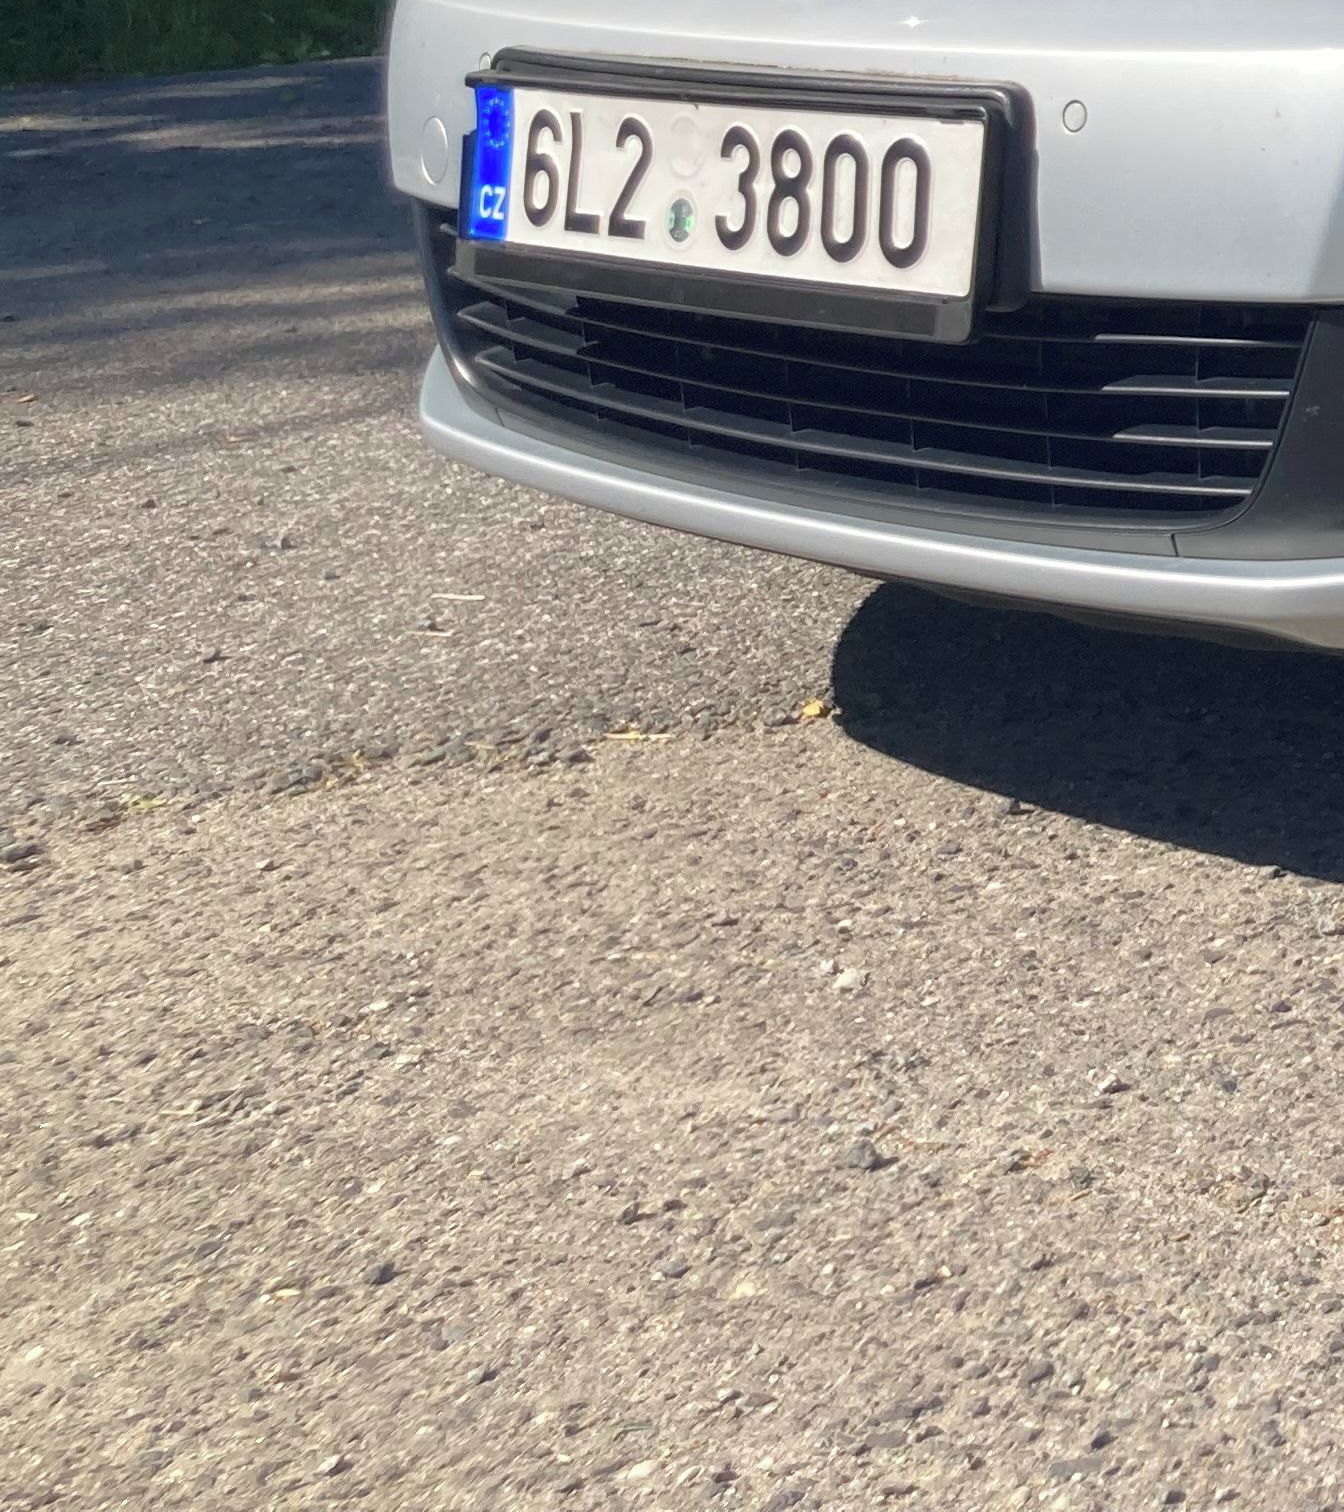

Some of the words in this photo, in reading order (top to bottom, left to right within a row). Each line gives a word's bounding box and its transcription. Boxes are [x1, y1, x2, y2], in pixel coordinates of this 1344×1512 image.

[479, 184, 506, 220] CZ
[523, 108, 653, 239] 6L2
[715, 125, 932, 268] 3800
